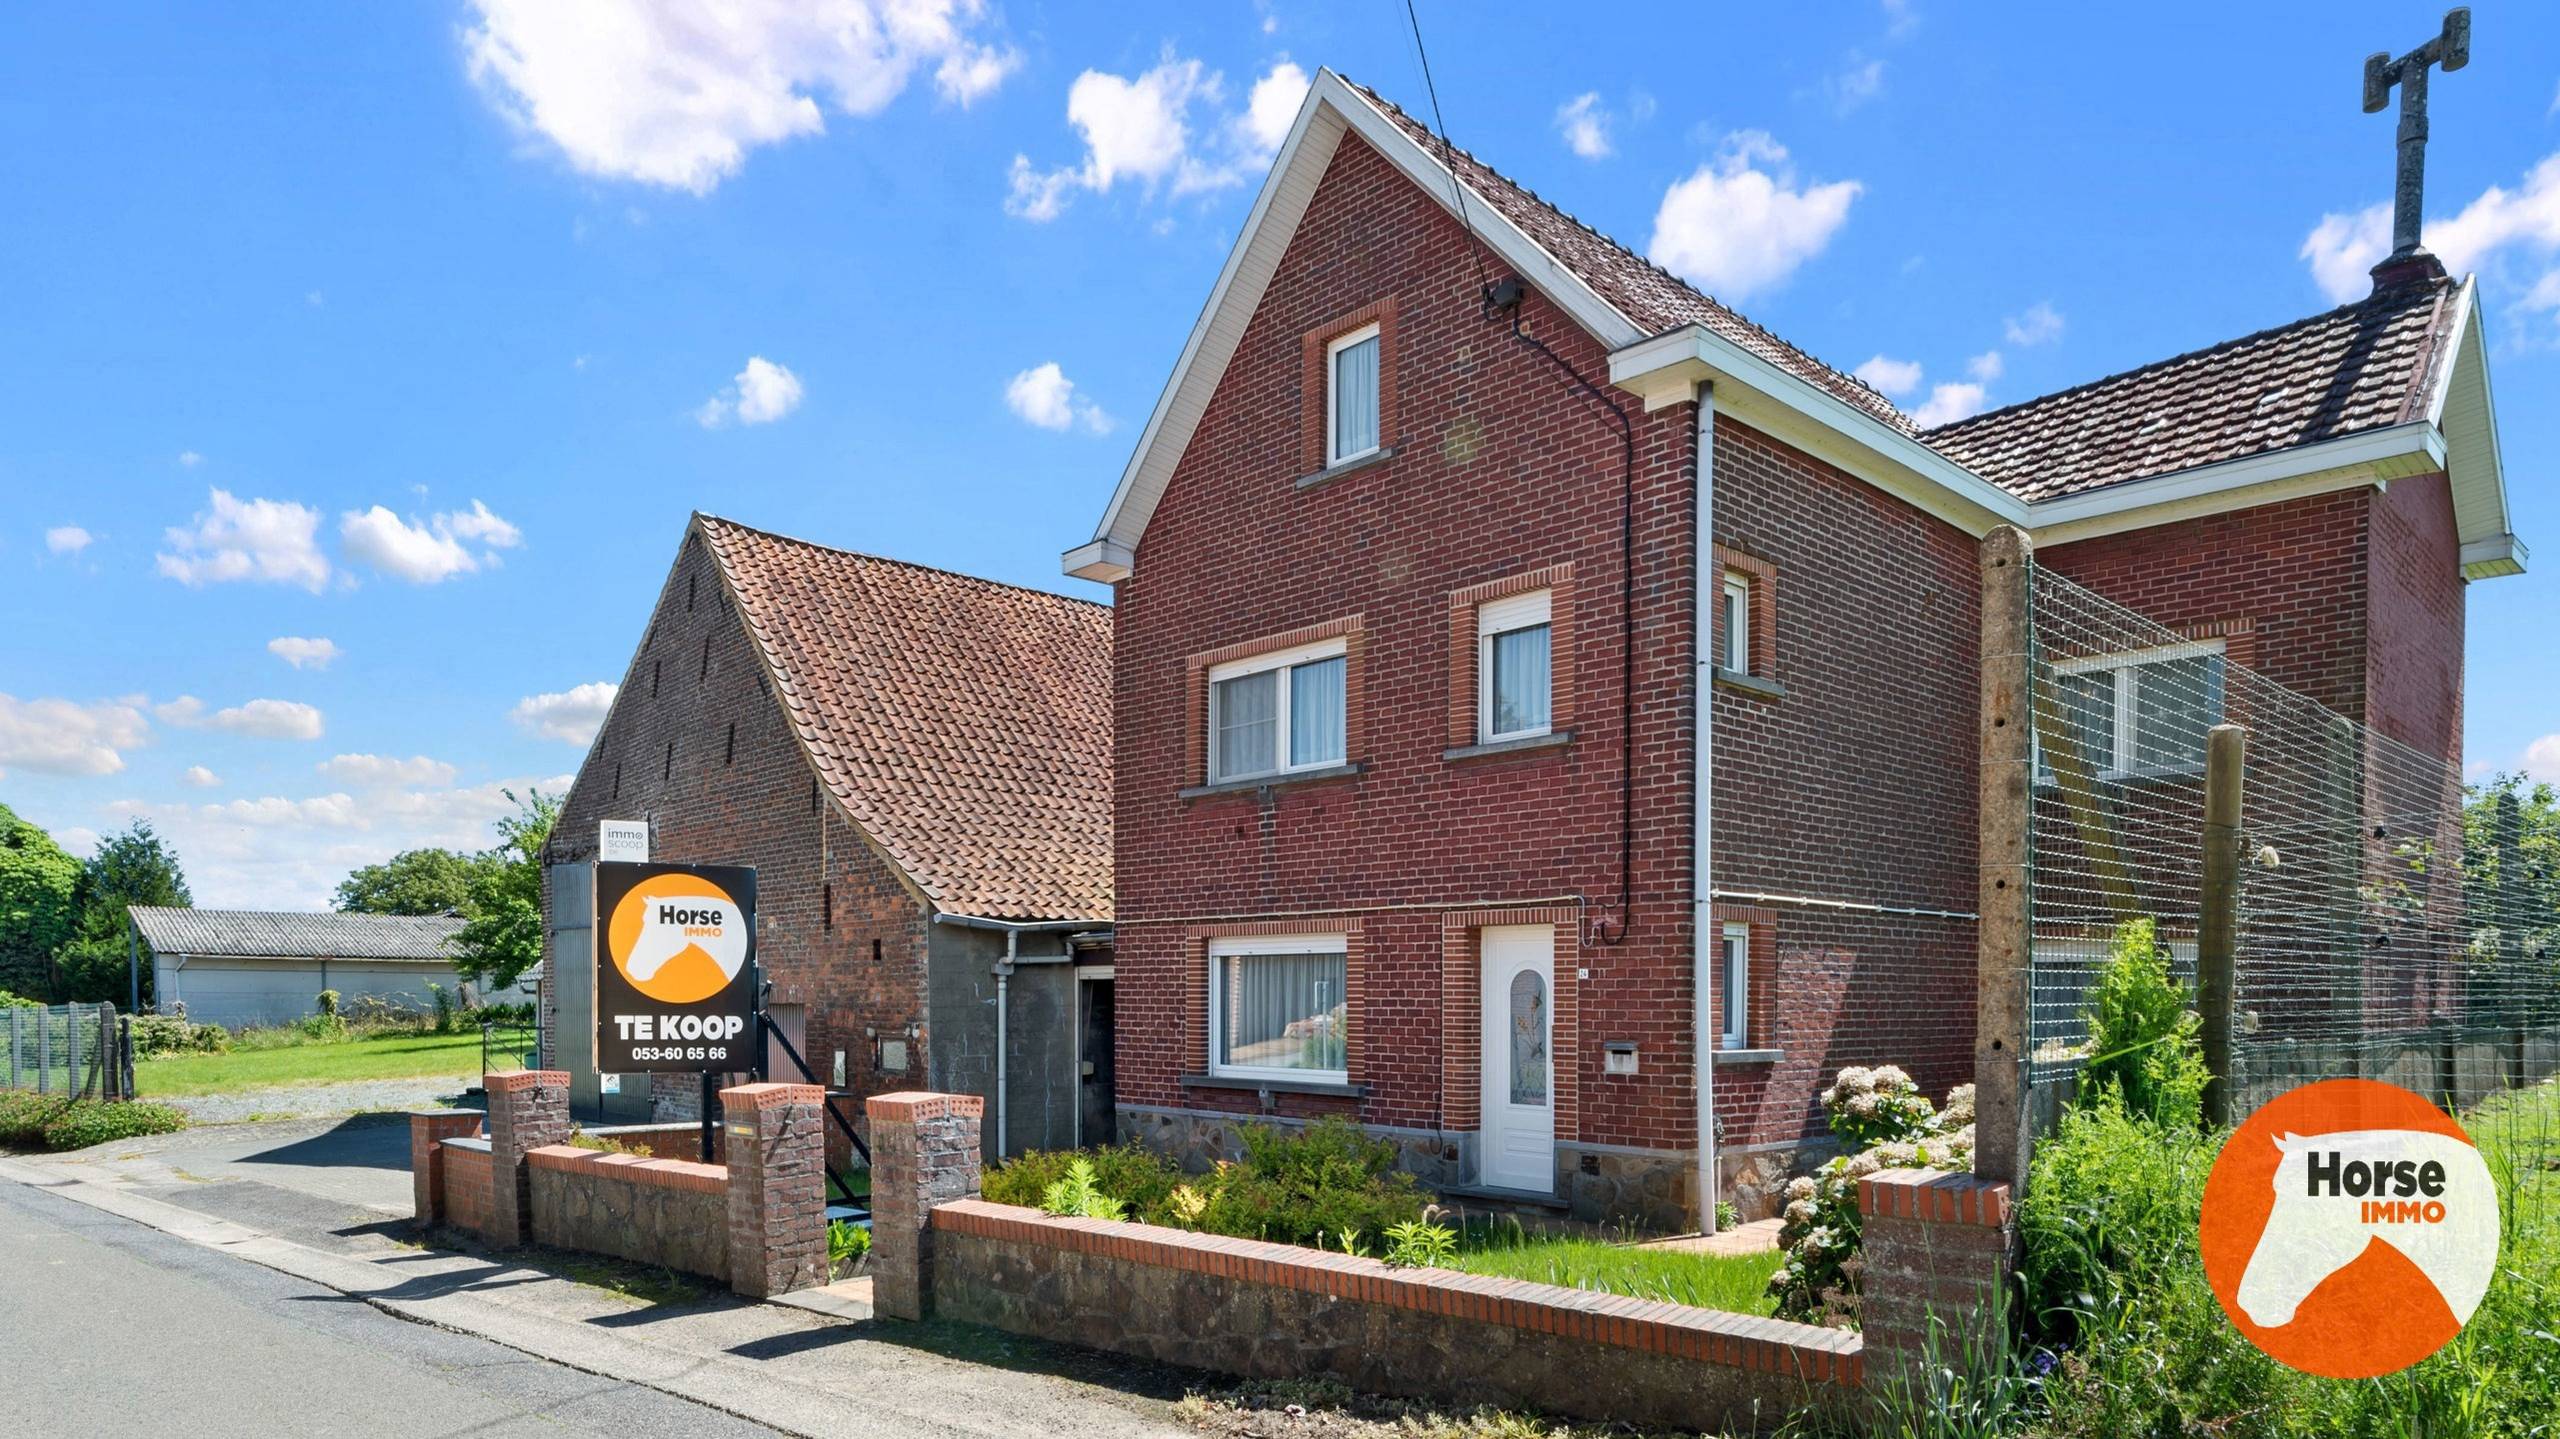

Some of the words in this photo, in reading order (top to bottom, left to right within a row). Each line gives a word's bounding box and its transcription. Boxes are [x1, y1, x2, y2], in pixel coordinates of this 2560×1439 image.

[608, 840, 643, 851] scoop
[659, 905, 722, 926] Horse
[684, 927, 722, 937] IMMO
[614, 1015, 653, 1040] TE
[659, 1015, 744, 1040] KOOP
[632, 1047, 682, 1060] 053-60
[687, 1048, 705, 1060] 65
[708, 1048, 727, 1060] 66
